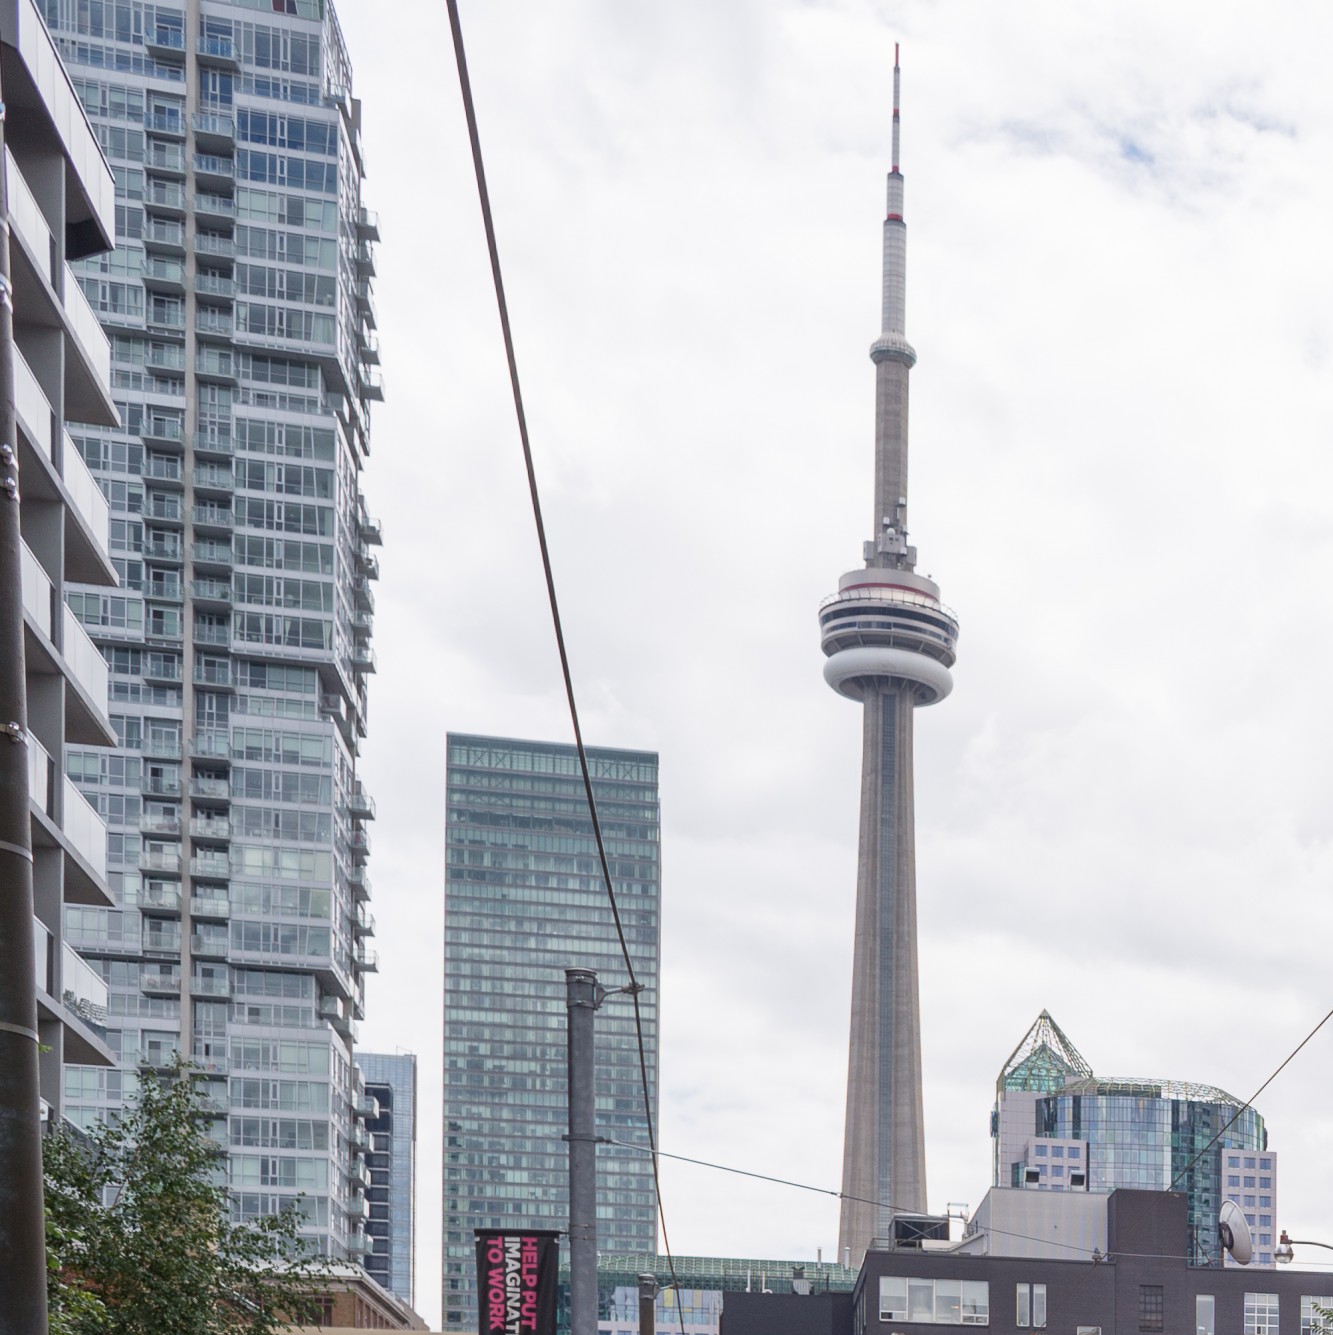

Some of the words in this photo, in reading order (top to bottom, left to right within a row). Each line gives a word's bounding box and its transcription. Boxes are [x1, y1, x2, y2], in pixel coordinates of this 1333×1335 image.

[487, 1236, 503, 1264] TO
[521, 1237, 538, 1288] HELP
[487, 1267, 506, 1330] WORK
[521, 1290, 537, 1330] PUT
